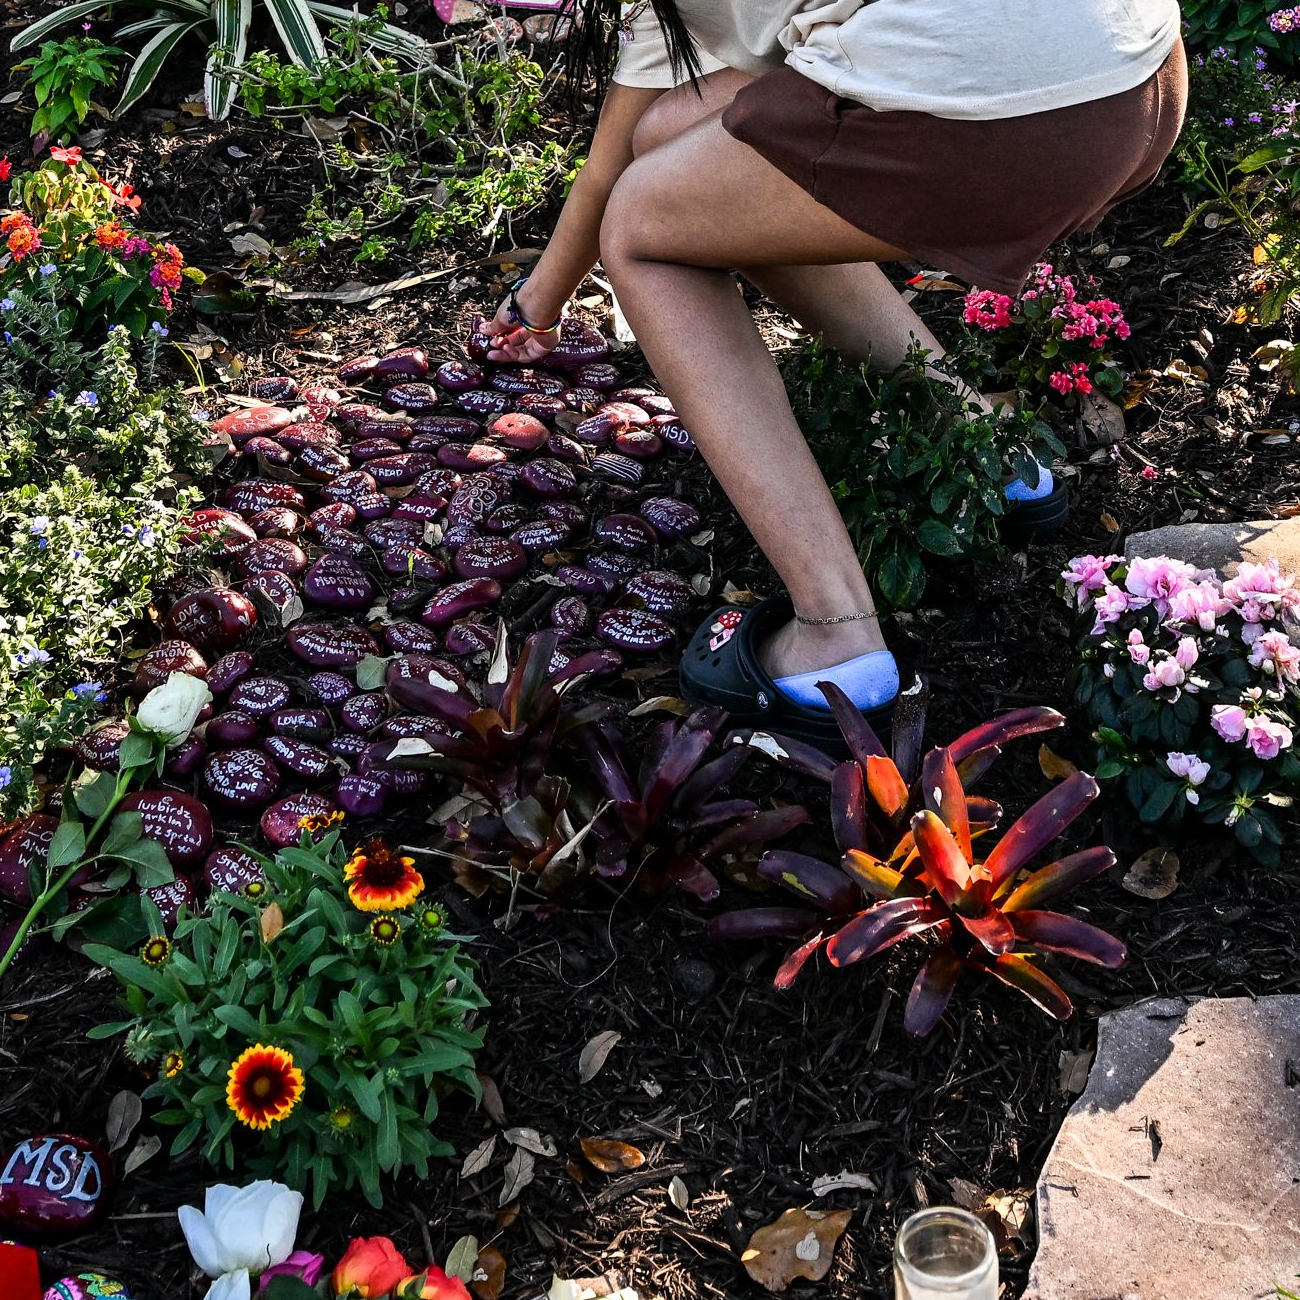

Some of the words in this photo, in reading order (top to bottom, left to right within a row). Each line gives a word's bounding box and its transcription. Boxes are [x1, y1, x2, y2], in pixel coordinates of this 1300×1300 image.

[660, 425, 690, 445] MSD
[518, 527, 552, 538] SPREAD
[522, 535, 542, 545] LOVE
[606, 617, 633, 635] SPREAD
[636, 628, 657, 636] LOVE
[237, 697, 267, 709] SPREAD
[268, 694, 285, 708] LOVE
[386, 722, 408, 734] LOVE
[236, 781, 258, 792] LOVE
[209, 868, 231, 892] LOVE
